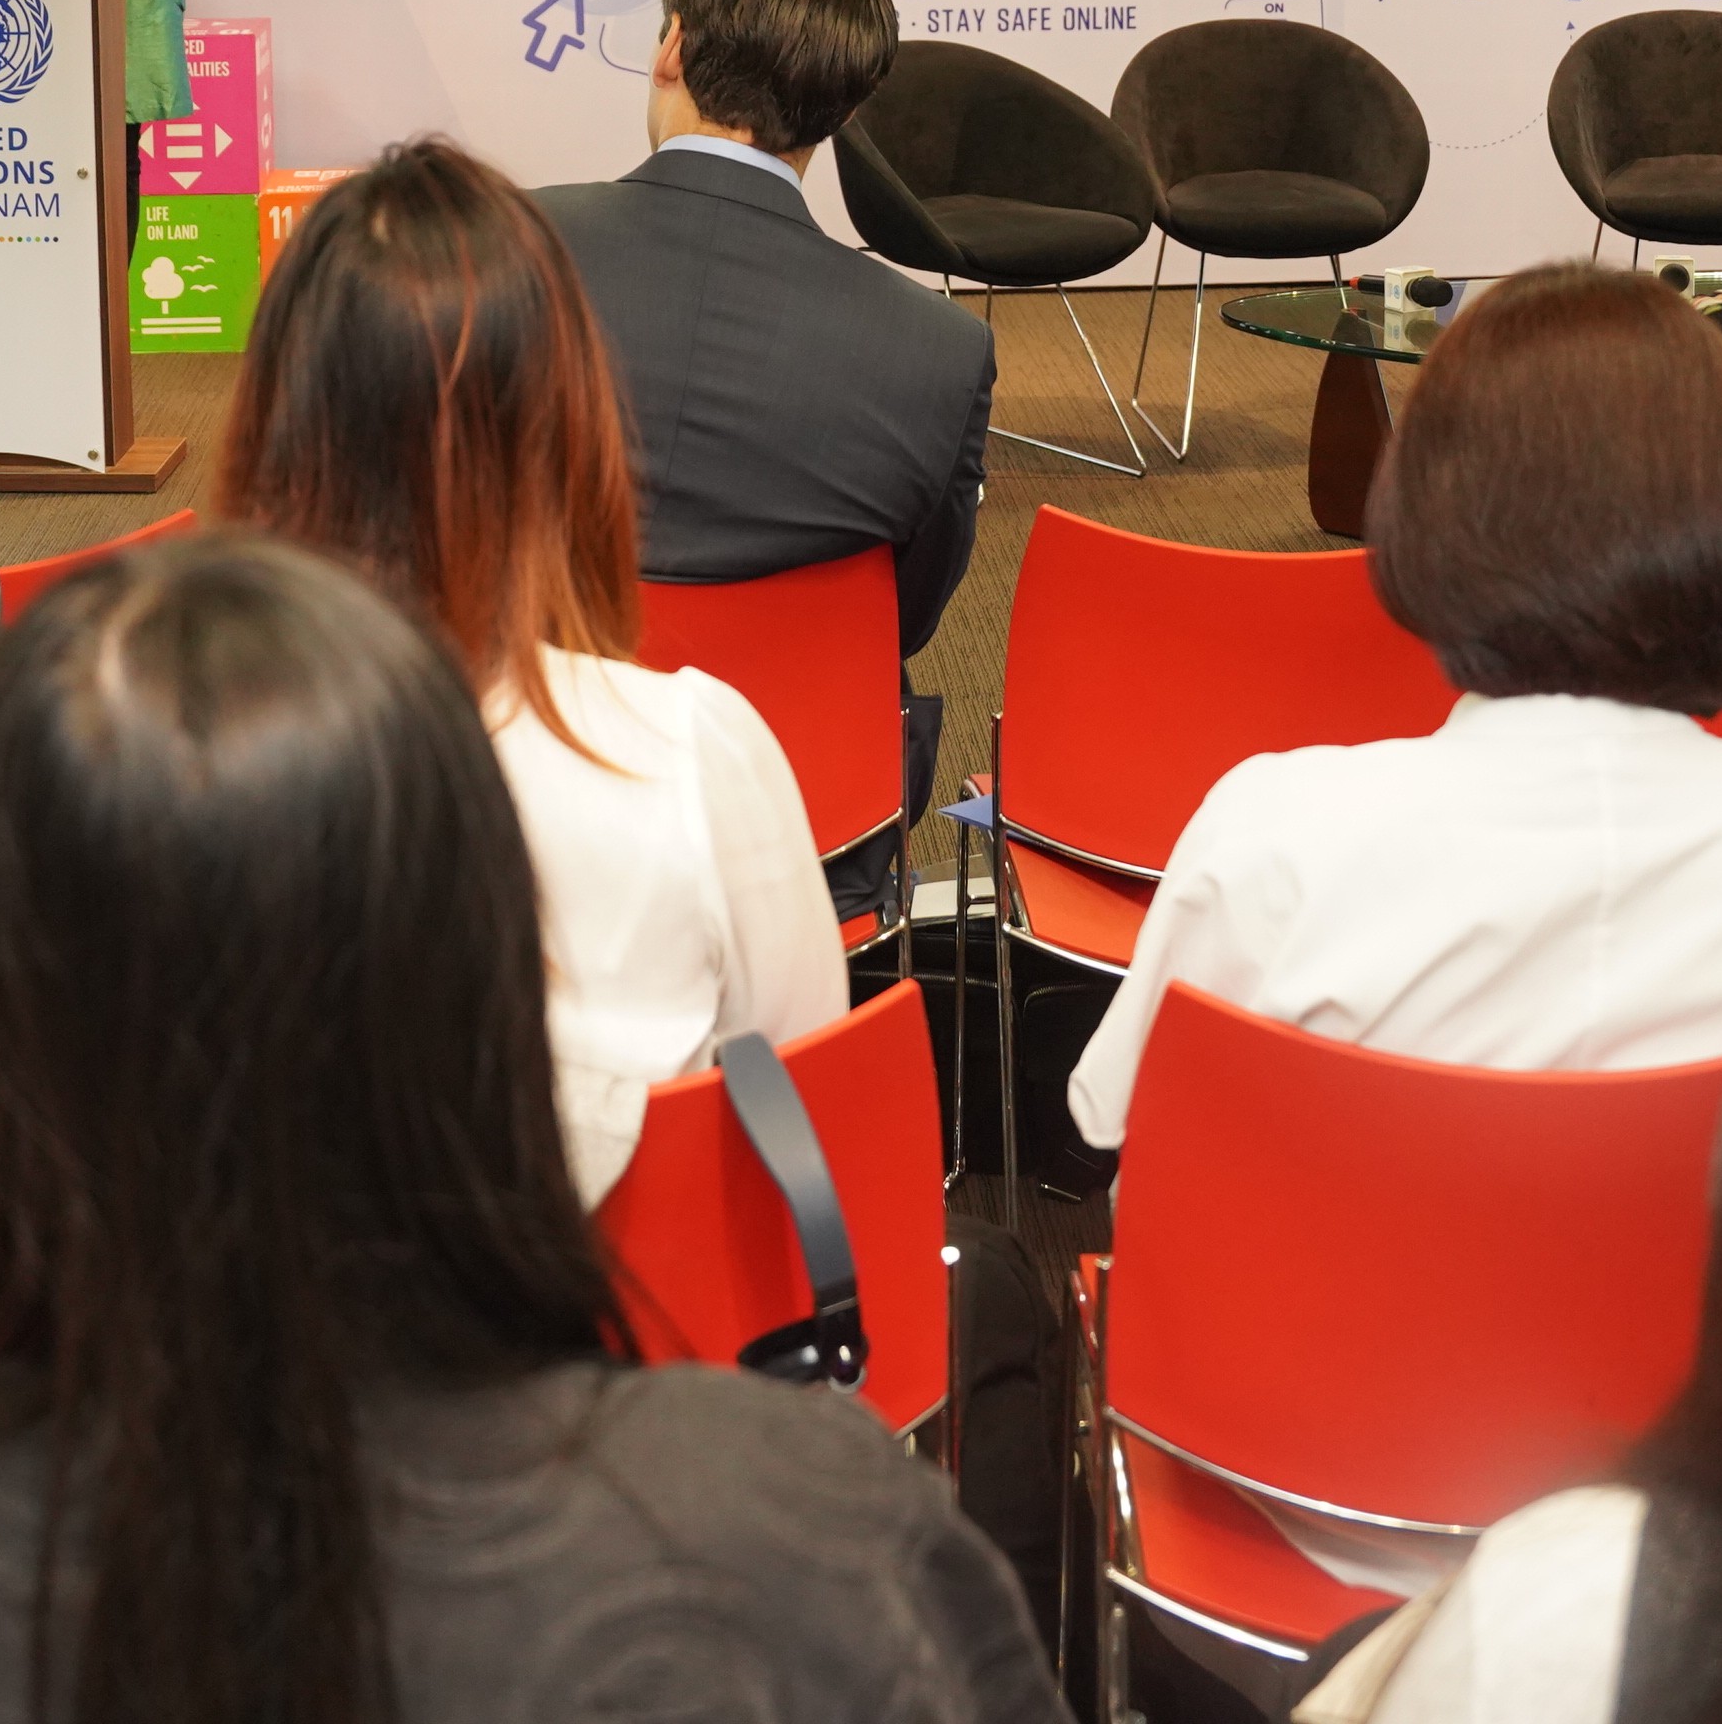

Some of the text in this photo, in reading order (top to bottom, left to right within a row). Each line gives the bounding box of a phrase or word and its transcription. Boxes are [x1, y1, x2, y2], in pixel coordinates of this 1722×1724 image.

[1264, 3, 1284, 14] ON
[928, 6, 1136, 33] STAY SAFE ONLINE
[146, 206, 169, 222] LIFE
[269, 206, 292, 239] 11
[147, 224, 198, 241] ON LAND
